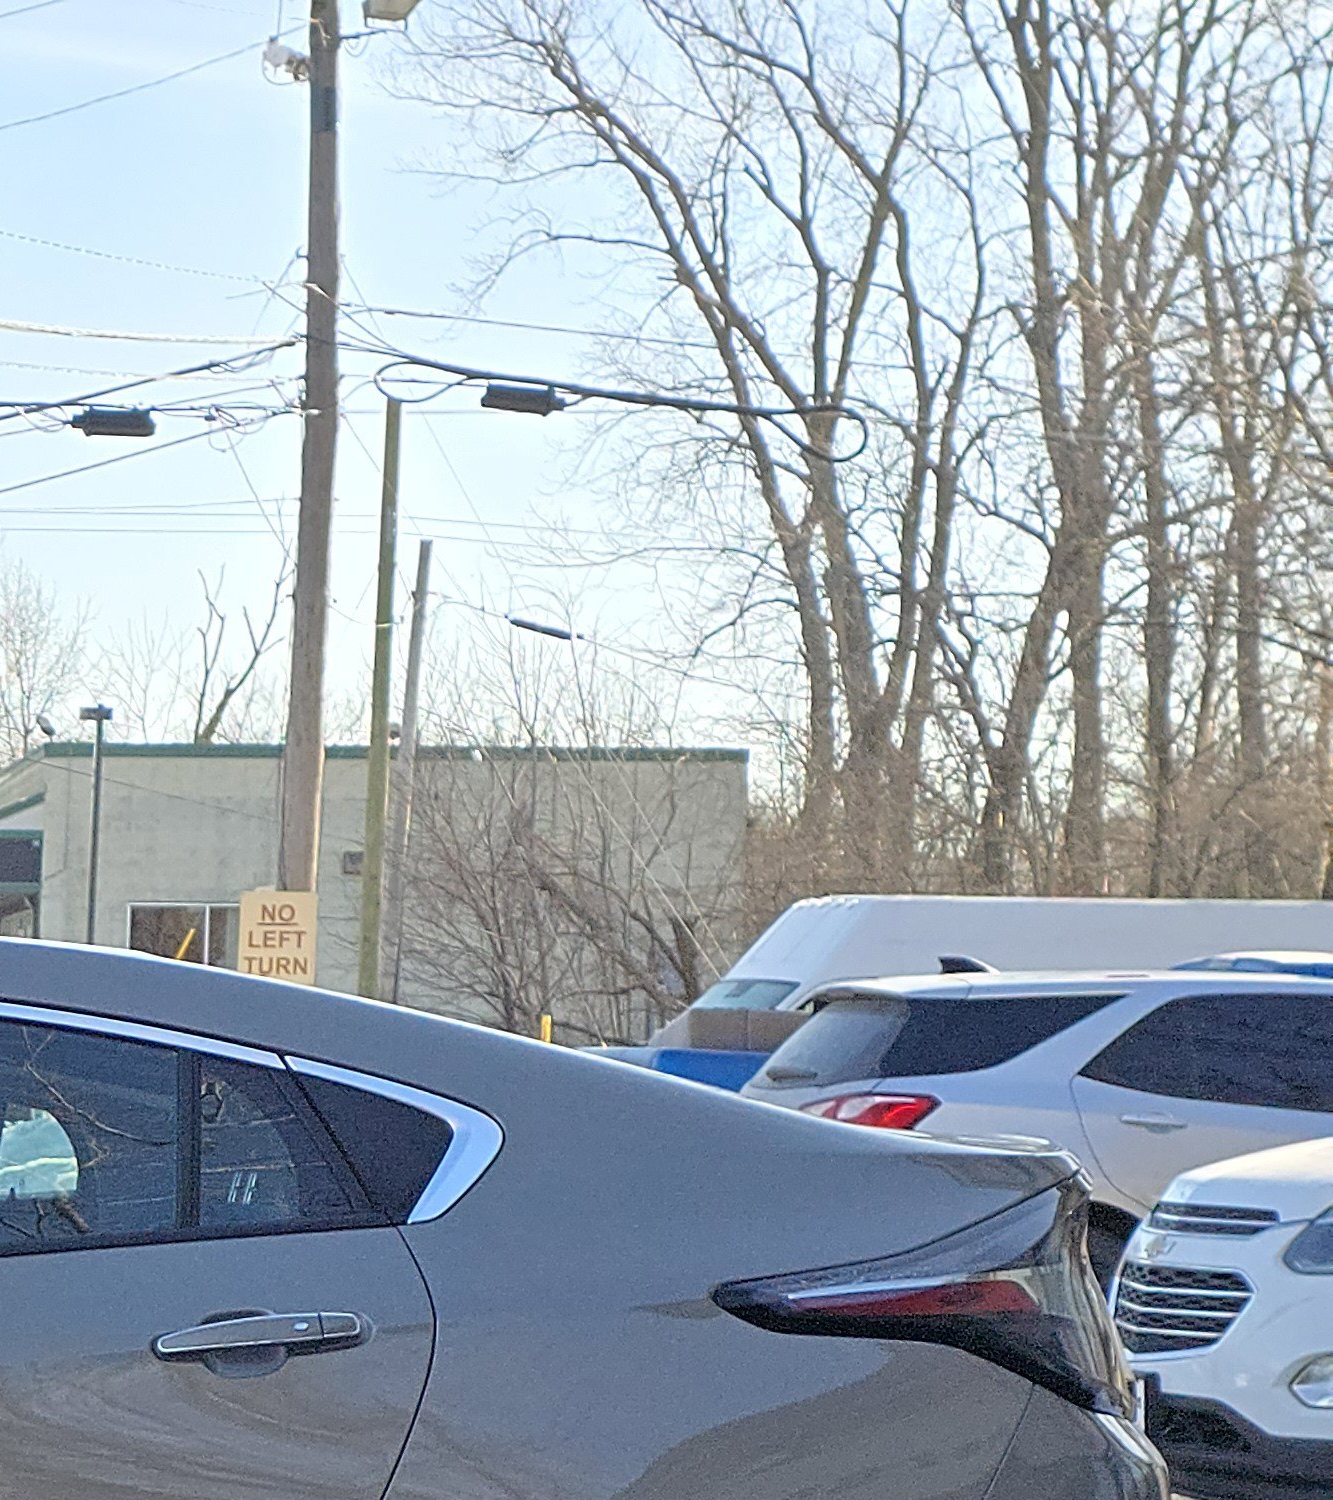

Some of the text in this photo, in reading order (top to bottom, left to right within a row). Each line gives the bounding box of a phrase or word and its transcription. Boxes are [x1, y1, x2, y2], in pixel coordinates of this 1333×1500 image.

[261, 903, 296, 922] NO
[247, 930, 307, 949] LEFT
[243, 956, 308, 976] TURN
